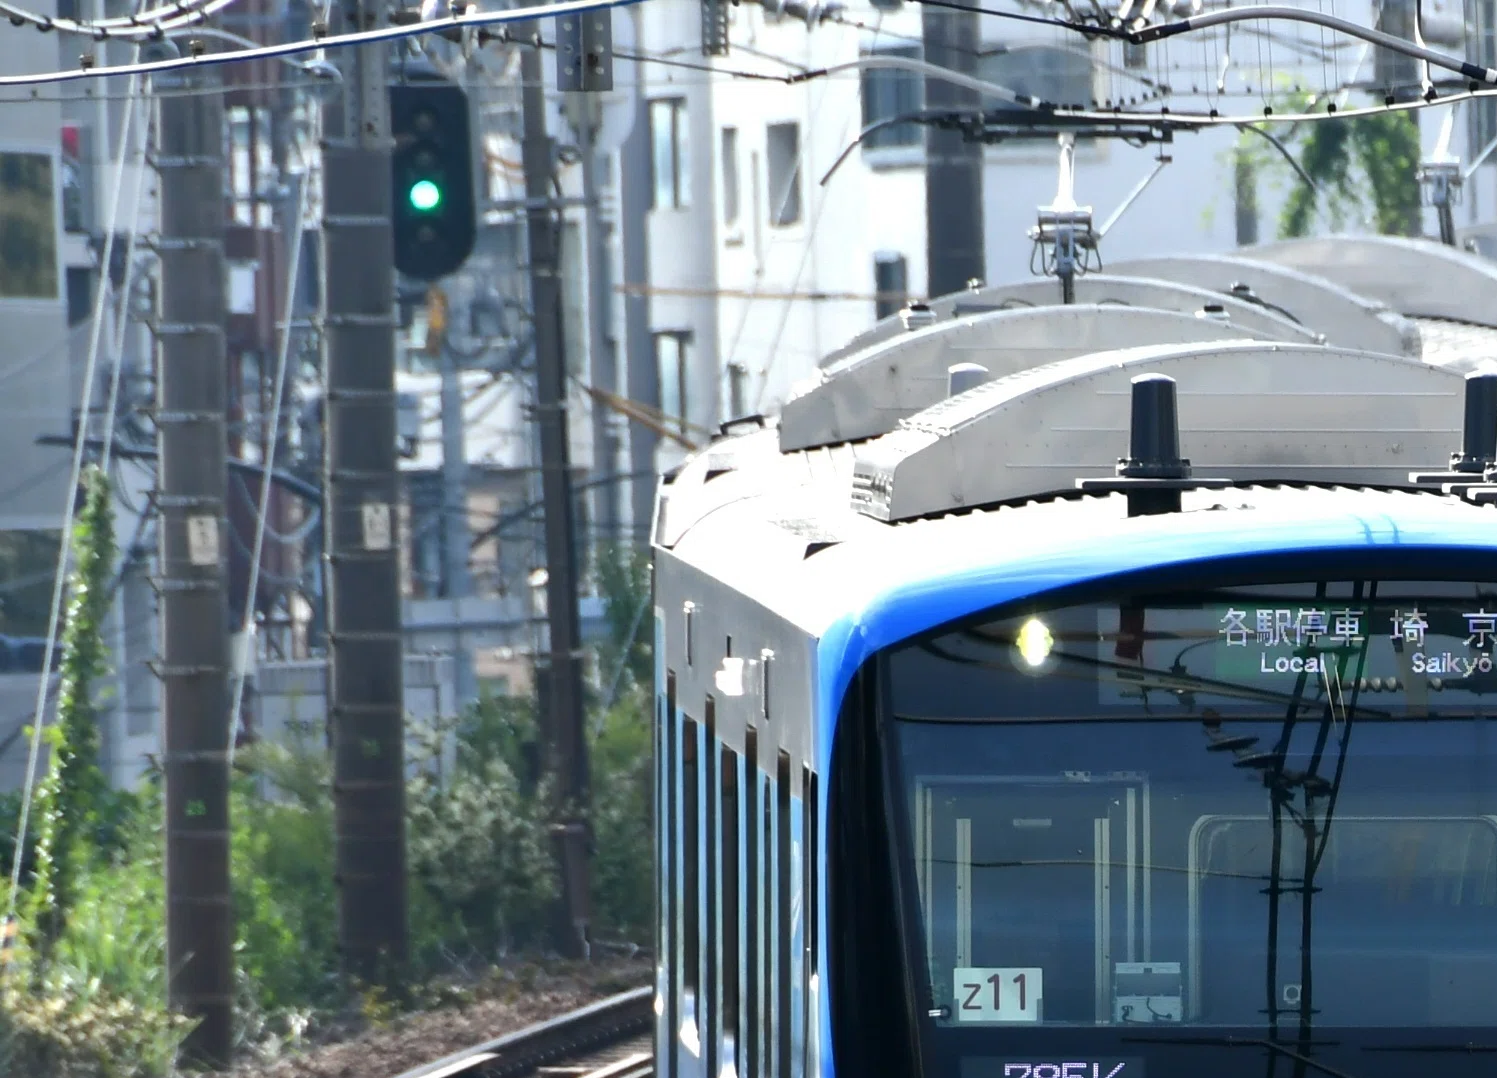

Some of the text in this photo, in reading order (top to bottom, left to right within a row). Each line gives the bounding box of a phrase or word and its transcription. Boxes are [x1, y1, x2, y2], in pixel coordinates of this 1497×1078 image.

[1218, 608, 1365, 647] 各駅停車
[1261, 653, 1325, 674] Local
[1411, 653, 1493, 678] Saikyō
